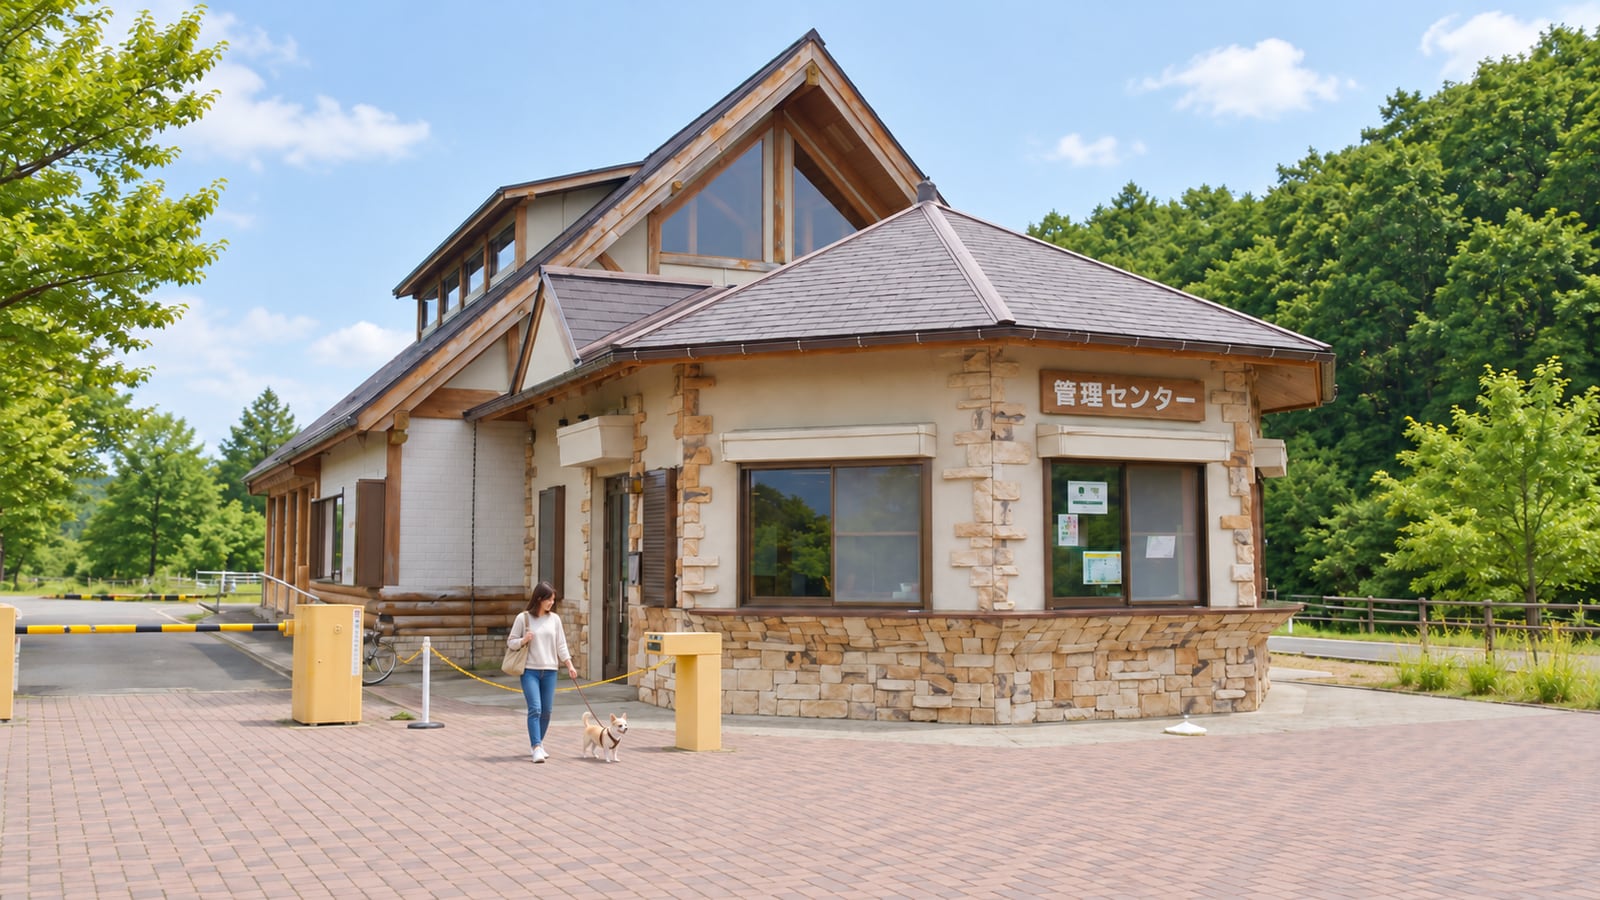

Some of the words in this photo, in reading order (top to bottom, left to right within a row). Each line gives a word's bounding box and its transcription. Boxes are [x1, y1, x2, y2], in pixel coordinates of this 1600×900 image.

[1054, 380, 1195, 411] 管理センター
